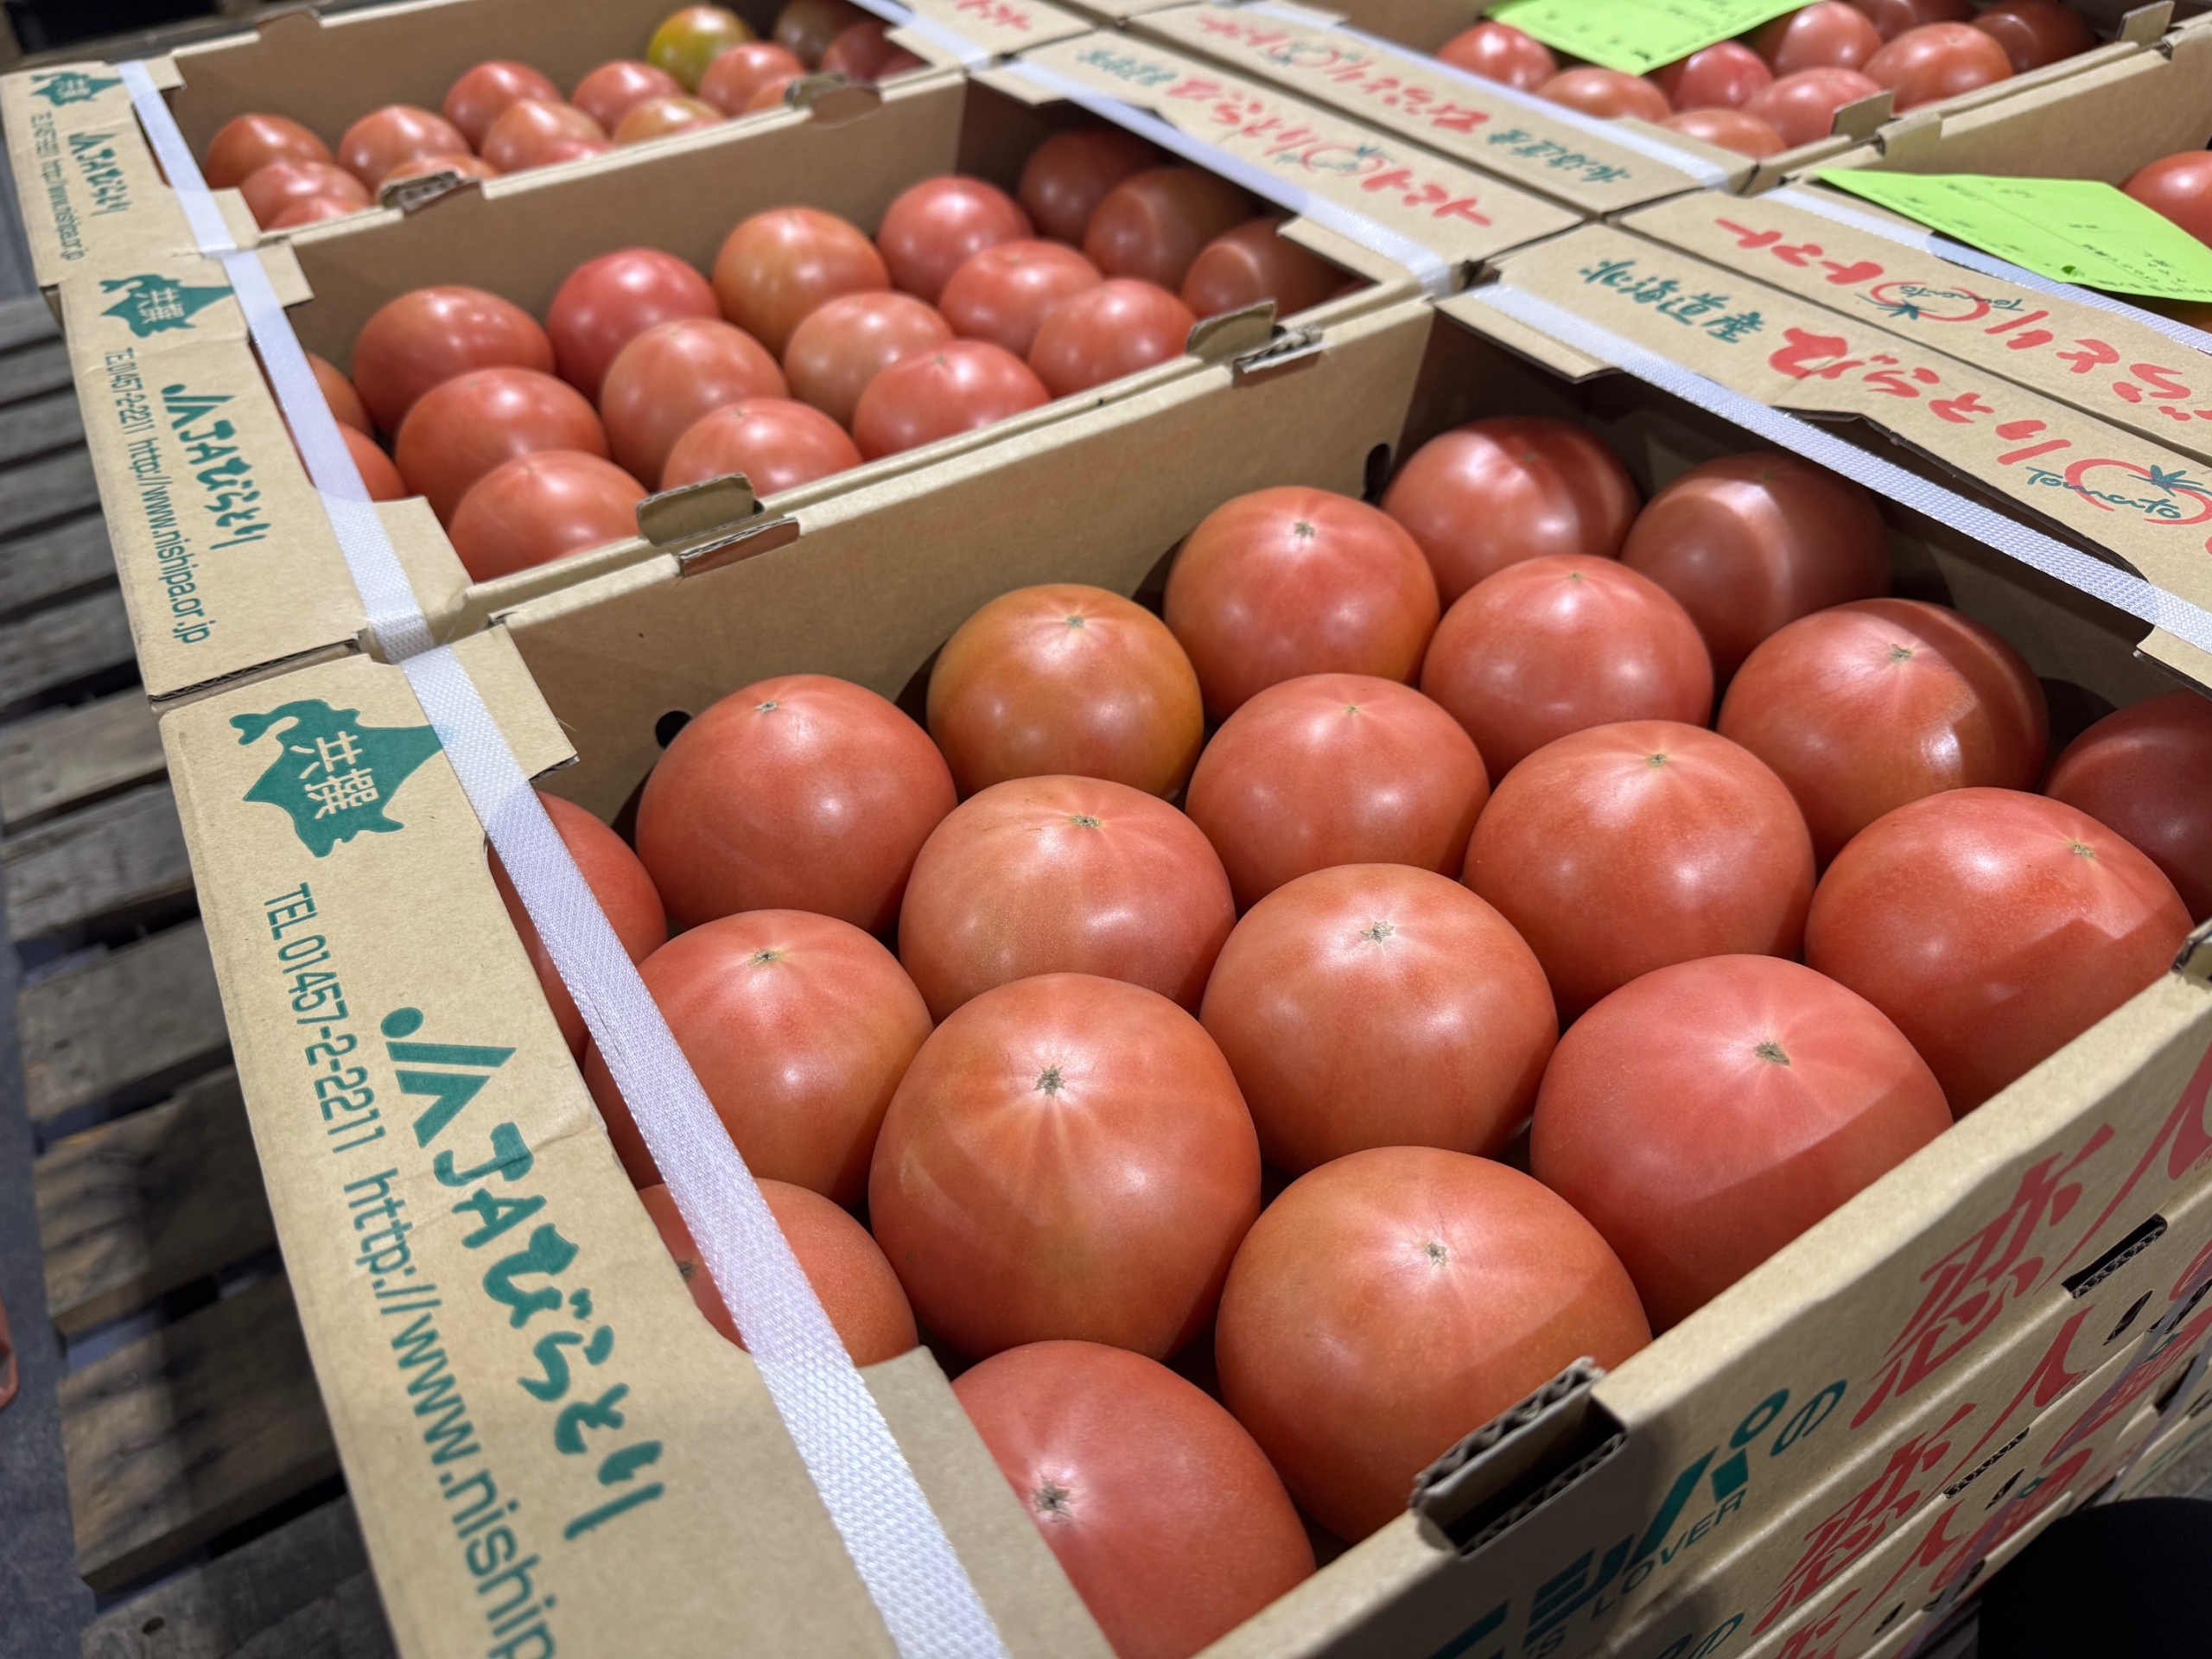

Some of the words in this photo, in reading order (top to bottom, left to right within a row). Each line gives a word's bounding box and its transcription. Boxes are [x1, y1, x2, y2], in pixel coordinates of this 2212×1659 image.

[1714, 218, 1885, 286] トマト
[1579, 261, 1764, 343] 北海道産
[1769, 327, 2073, 467] びらとり
[127, 436, 216, 644] http://www.nishipa.or.jp
[264, 881, 318, 941] TEL
[277, 934, 386, 1154] 01457-2-2211
[432, 1122, 665, 1541] JAびらとり
[1591, 1487, 1748, 1621] LOVER
